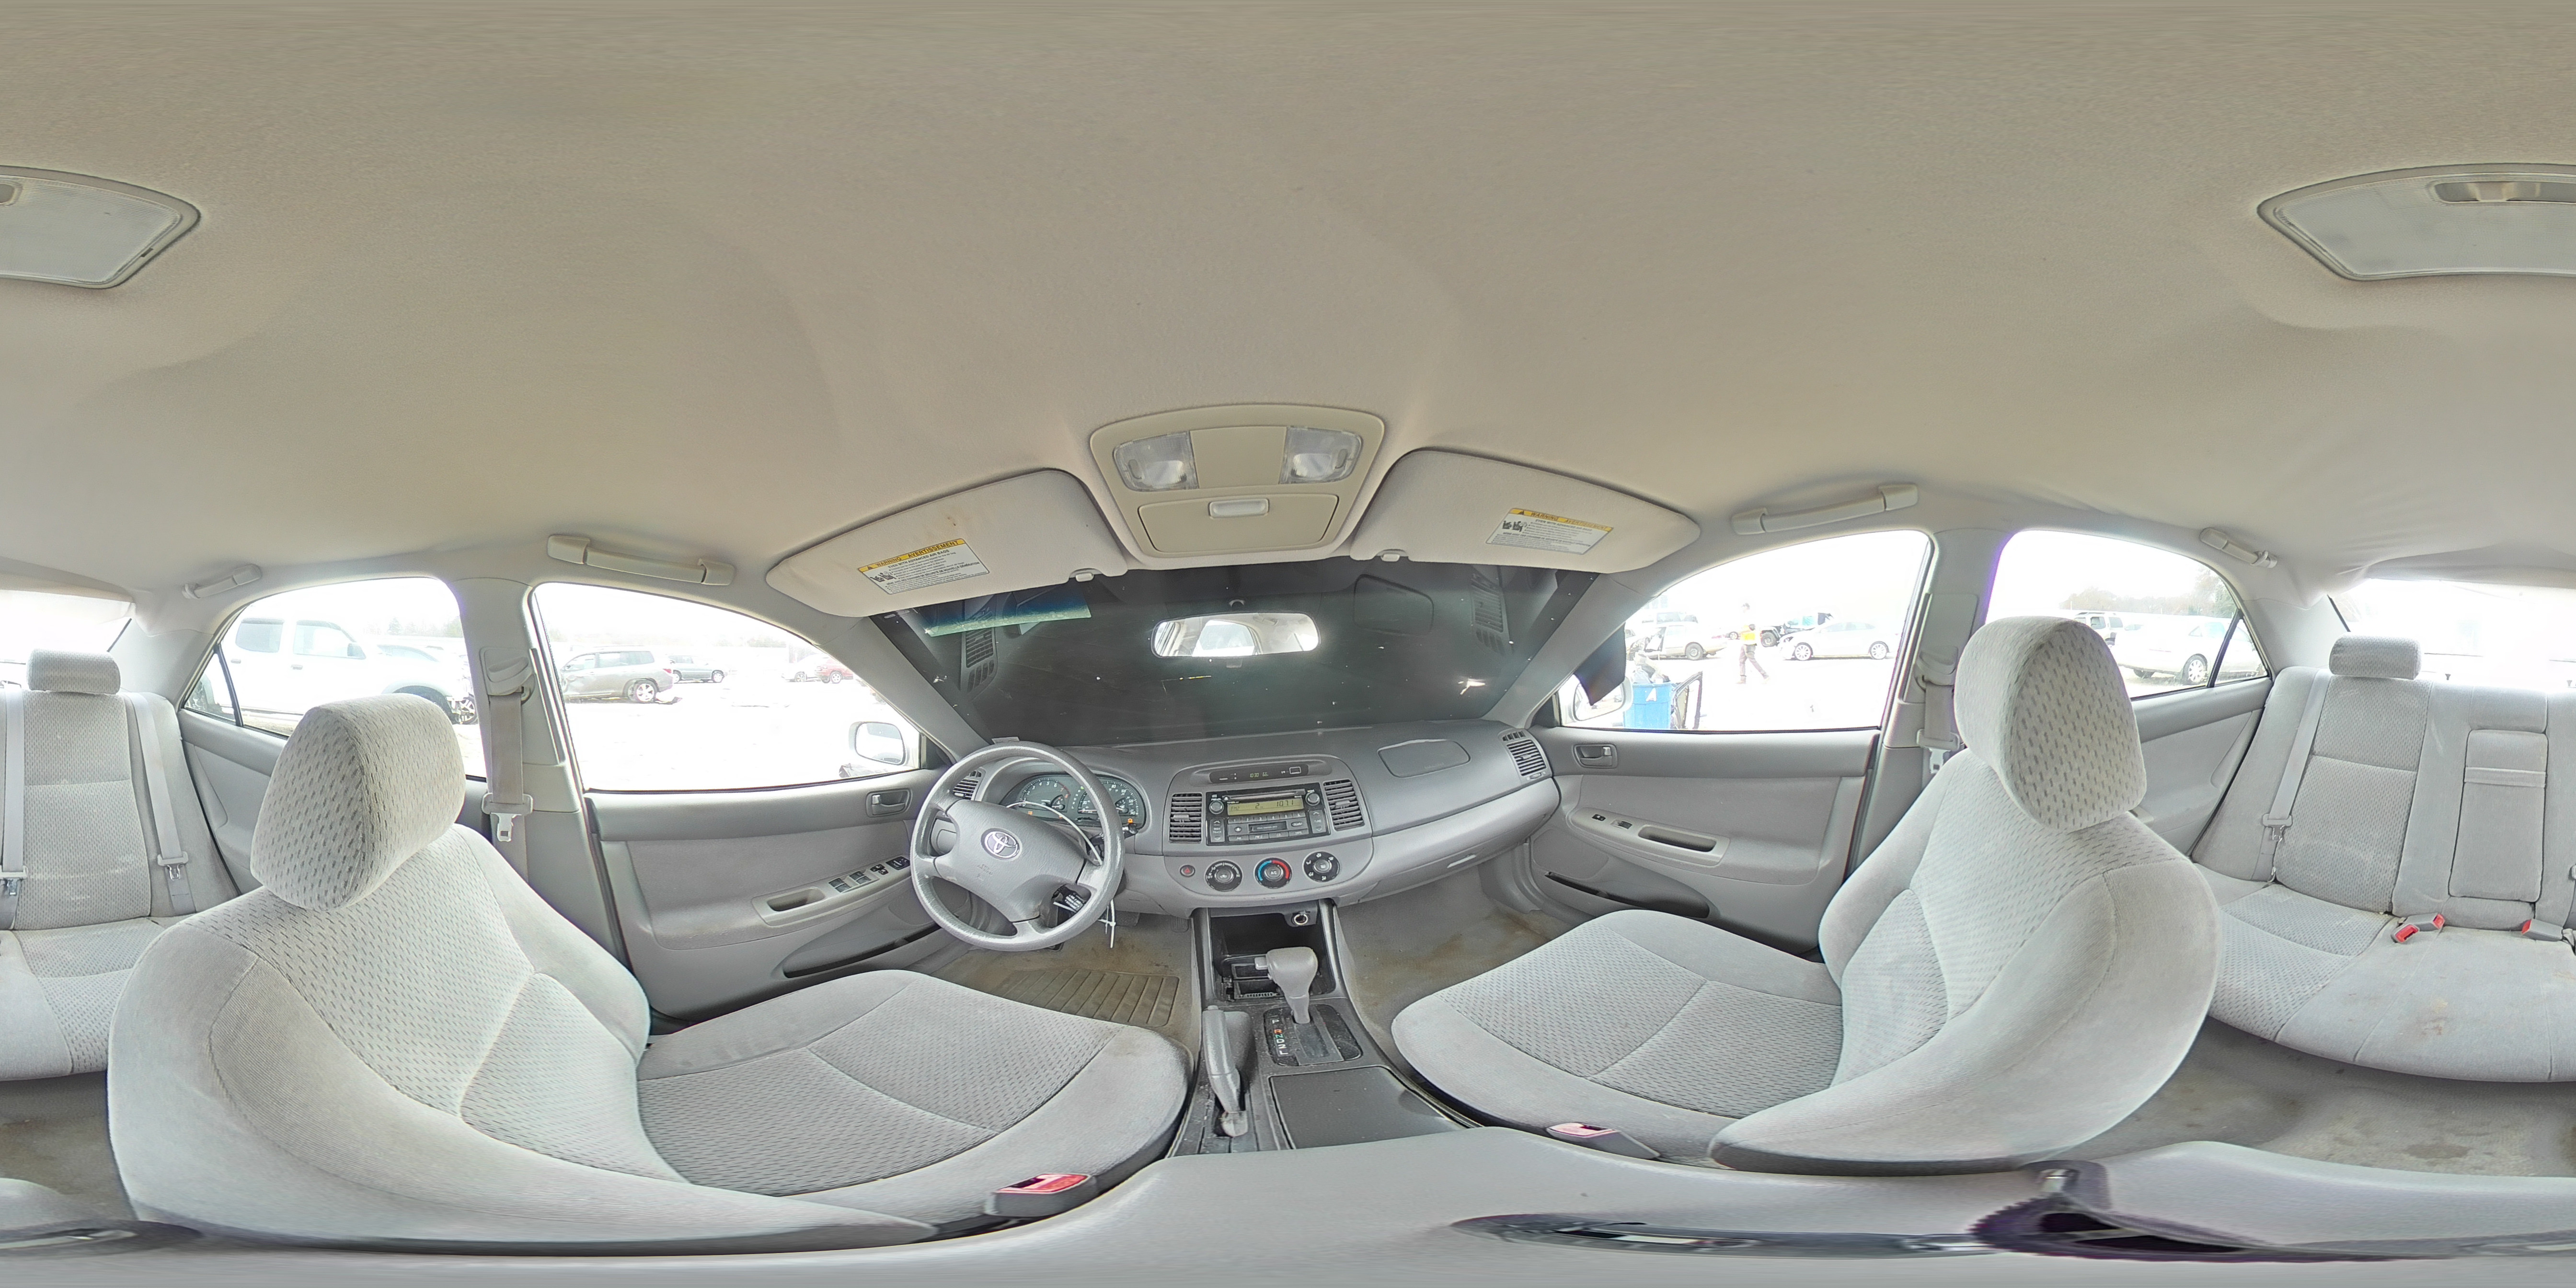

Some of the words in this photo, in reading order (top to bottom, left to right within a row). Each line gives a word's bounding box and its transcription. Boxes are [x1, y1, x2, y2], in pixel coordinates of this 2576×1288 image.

[1530, 512, 1559, 520] WARNING
[875, 557, 902, 566] WARNING
[906, 540, 959, 558] AVERTISSEMENT
